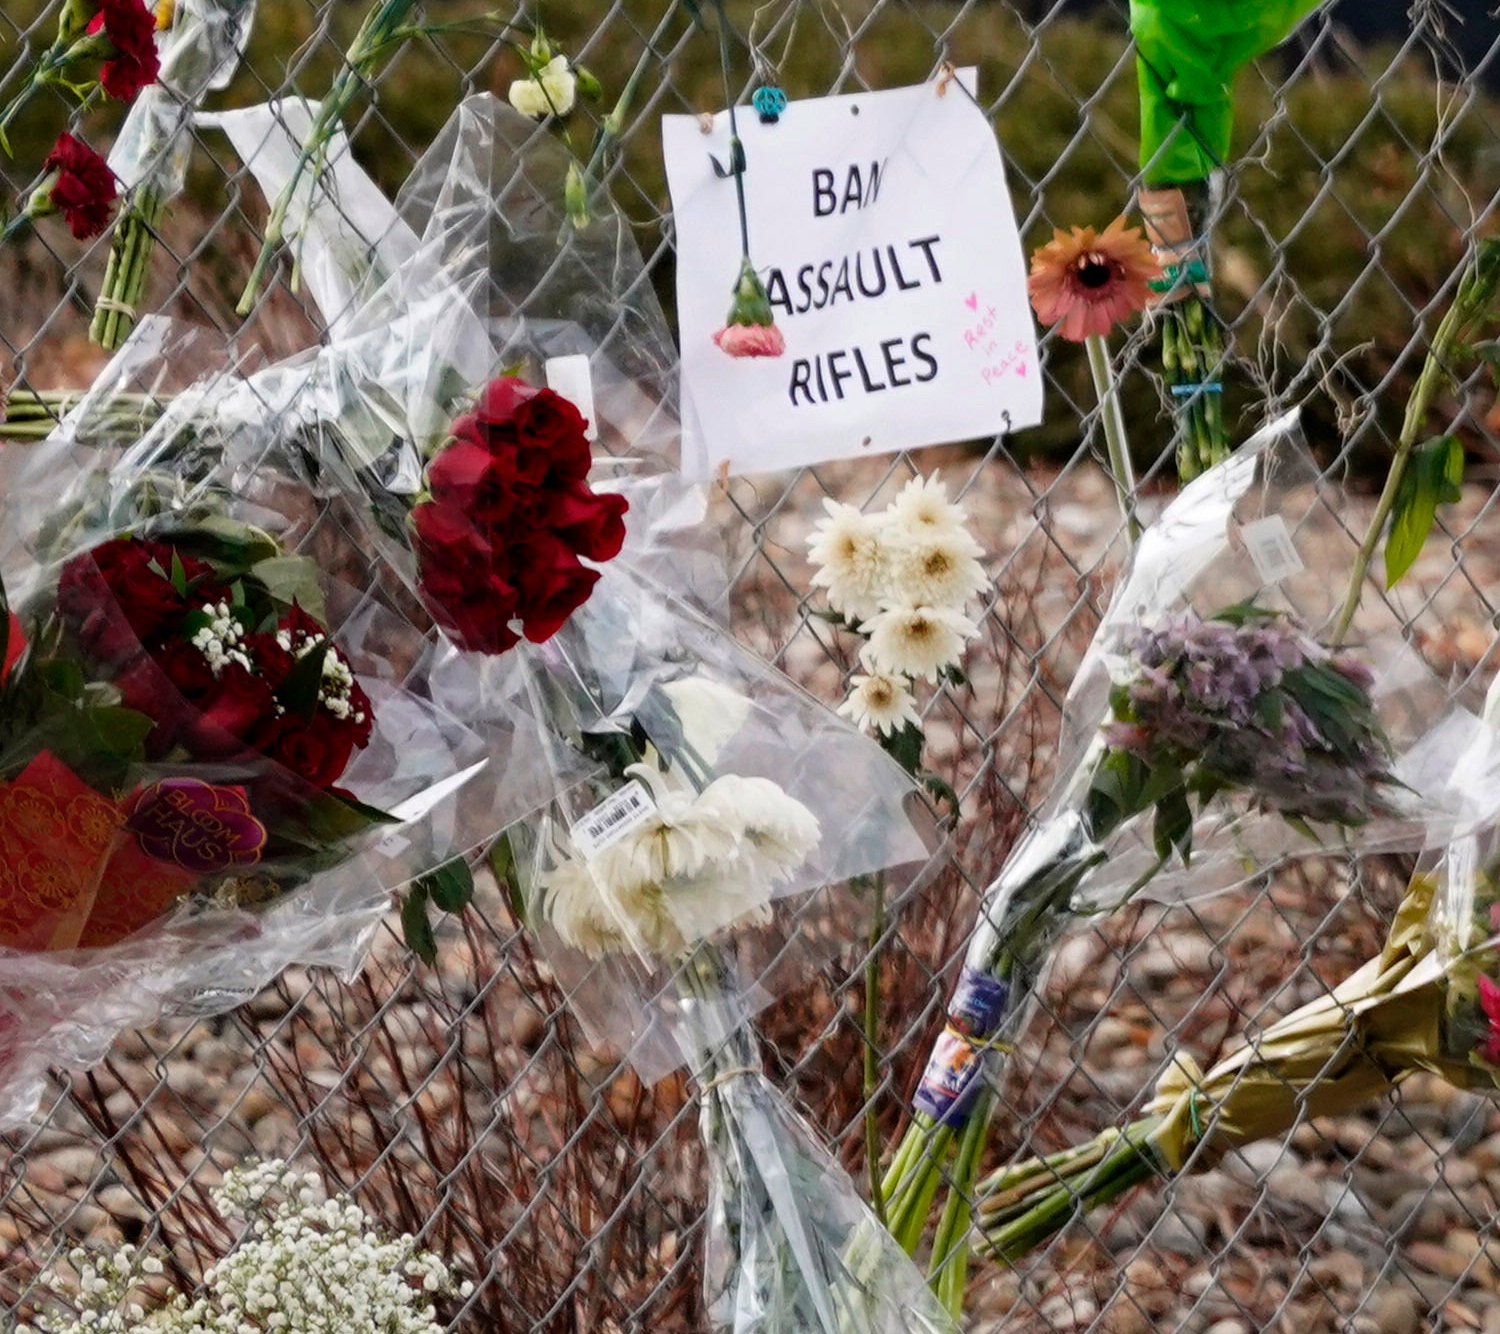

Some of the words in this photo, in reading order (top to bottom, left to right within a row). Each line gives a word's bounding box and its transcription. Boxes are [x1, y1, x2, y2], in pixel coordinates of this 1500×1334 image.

[812, 157, 889, 217] BAN
[765, 235, 943, 316] ASSAULT
[788, 332, 939, 406] RIFLES
